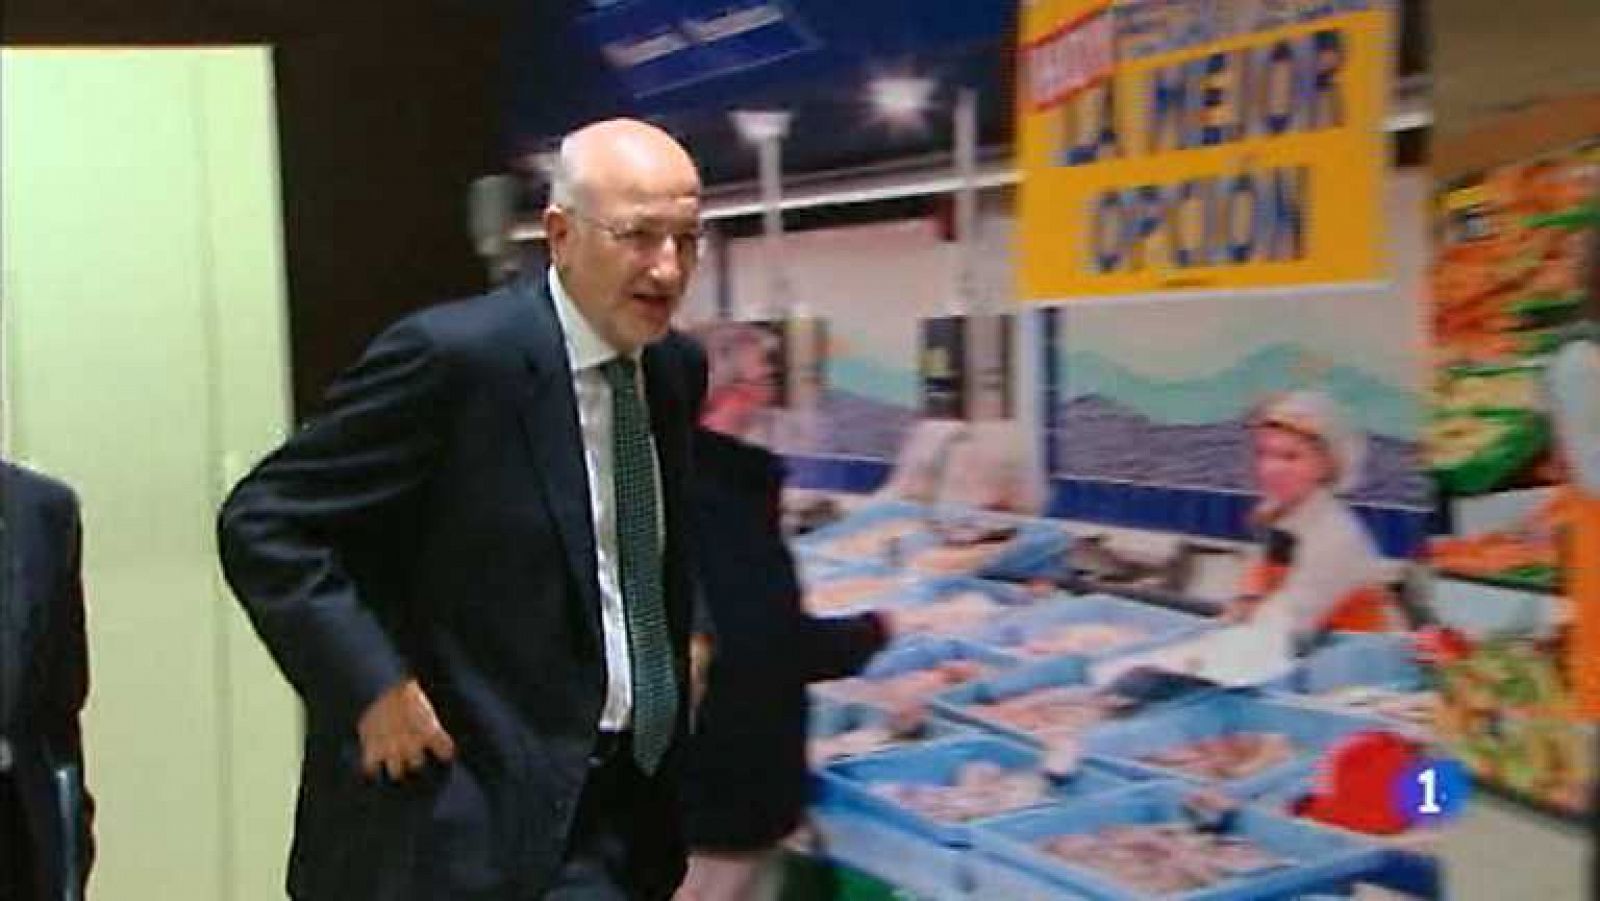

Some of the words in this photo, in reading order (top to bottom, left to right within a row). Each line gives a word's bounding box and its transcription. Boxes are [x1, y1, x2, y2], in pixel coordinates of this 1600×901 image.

[1061, 78, 1125, 166] LA
[1148, 28, 1346, 152] MEJOR
[1090, 157, 1310, 275] OPCIÓN
